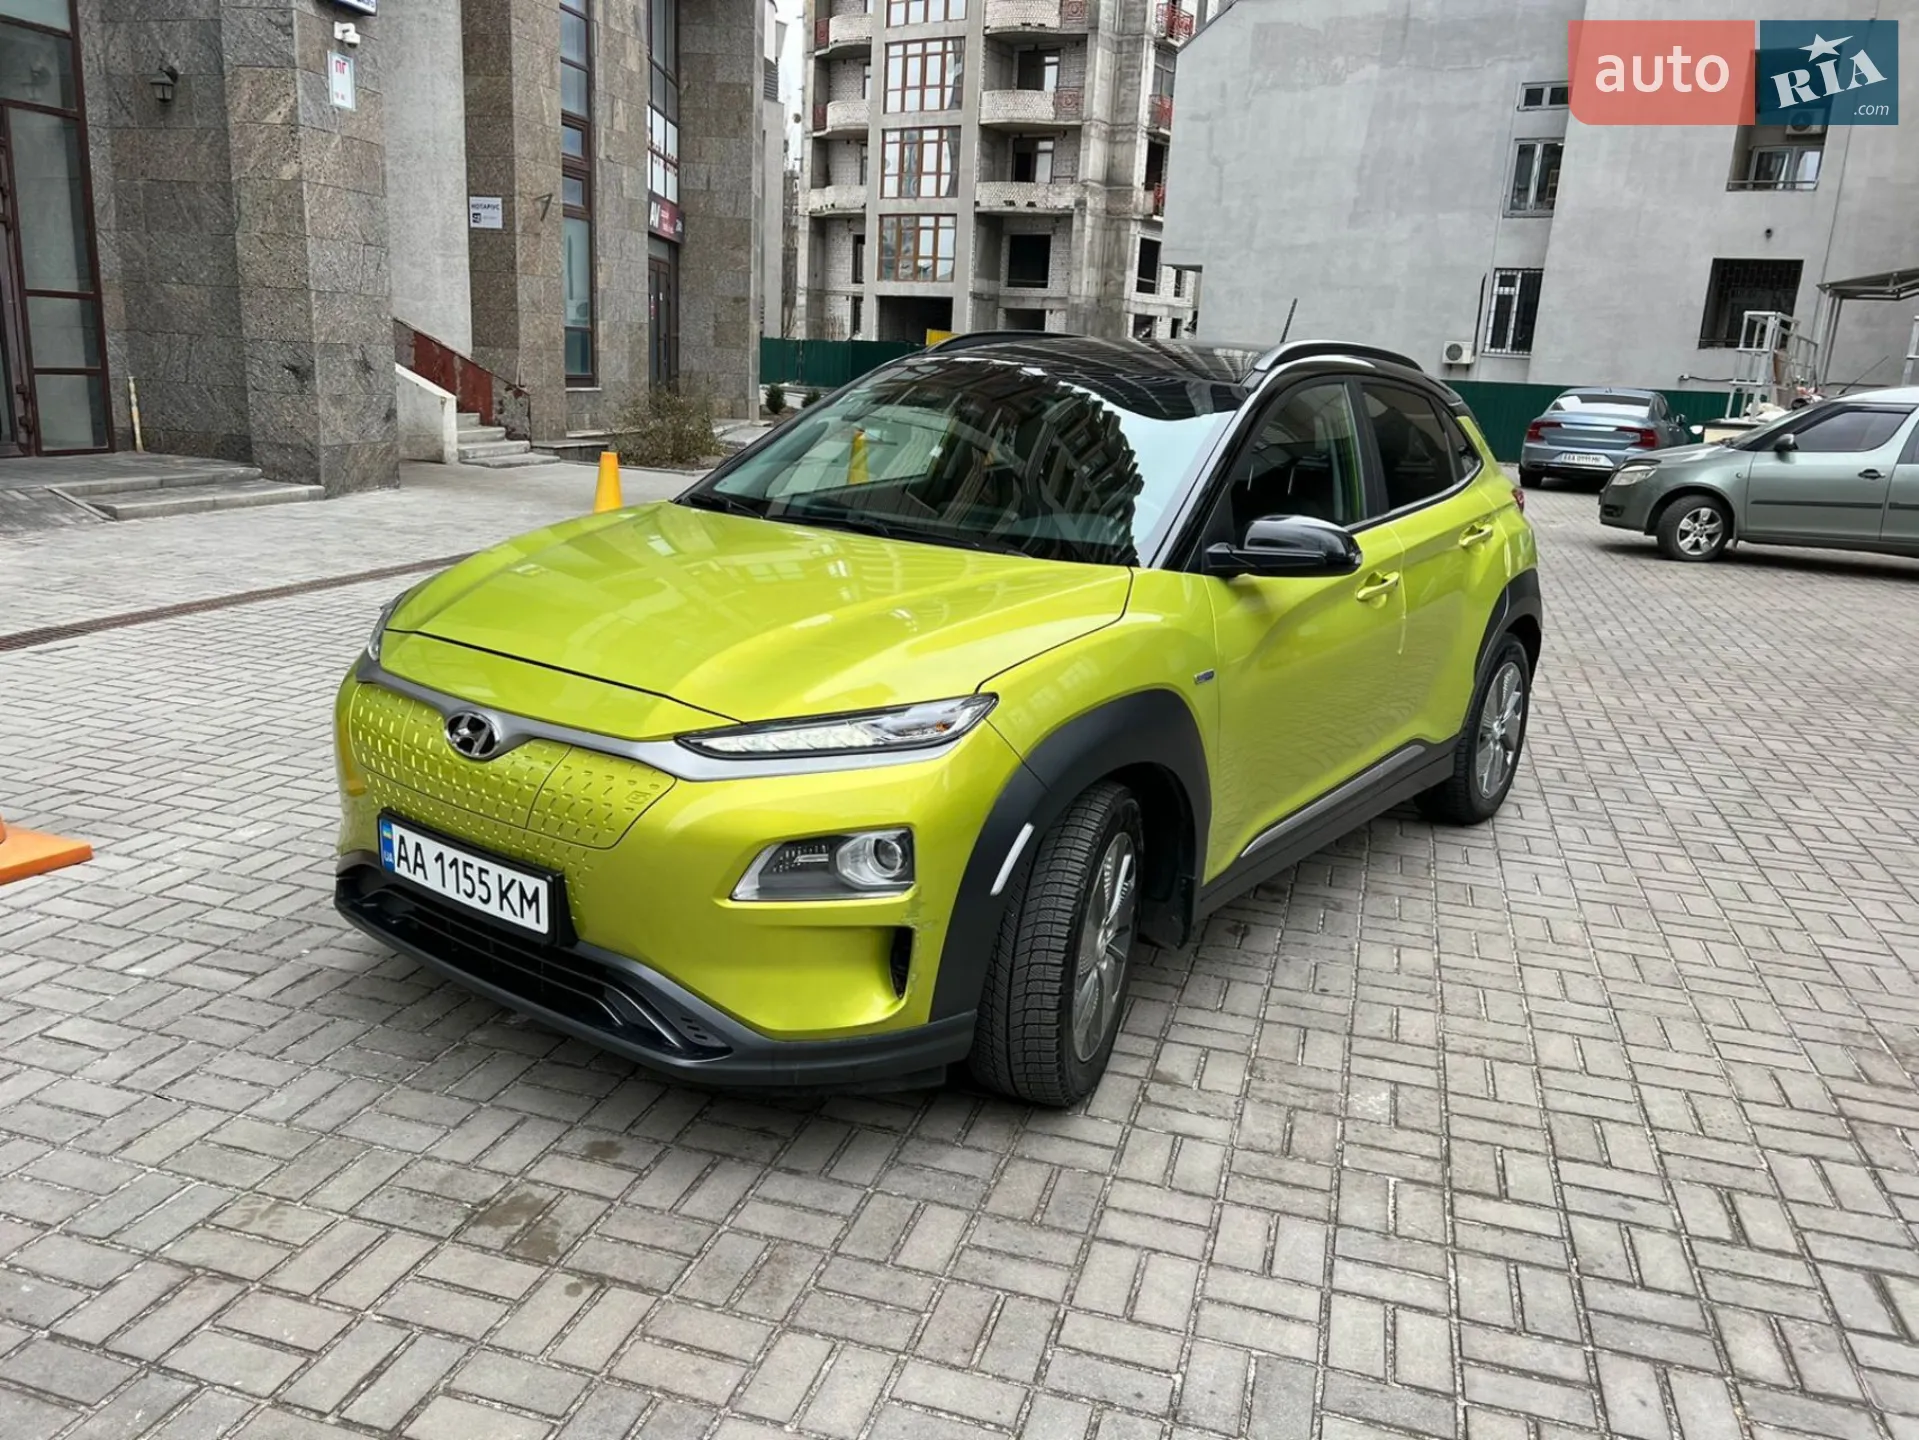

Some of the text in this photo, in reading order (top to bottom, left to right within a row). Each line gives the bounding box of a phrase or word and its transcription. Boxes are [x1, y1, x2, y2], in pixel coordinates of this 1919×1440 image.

[383, 849, 395, 864] UA
[397, 834, 542, 925] AA 1155 KM
